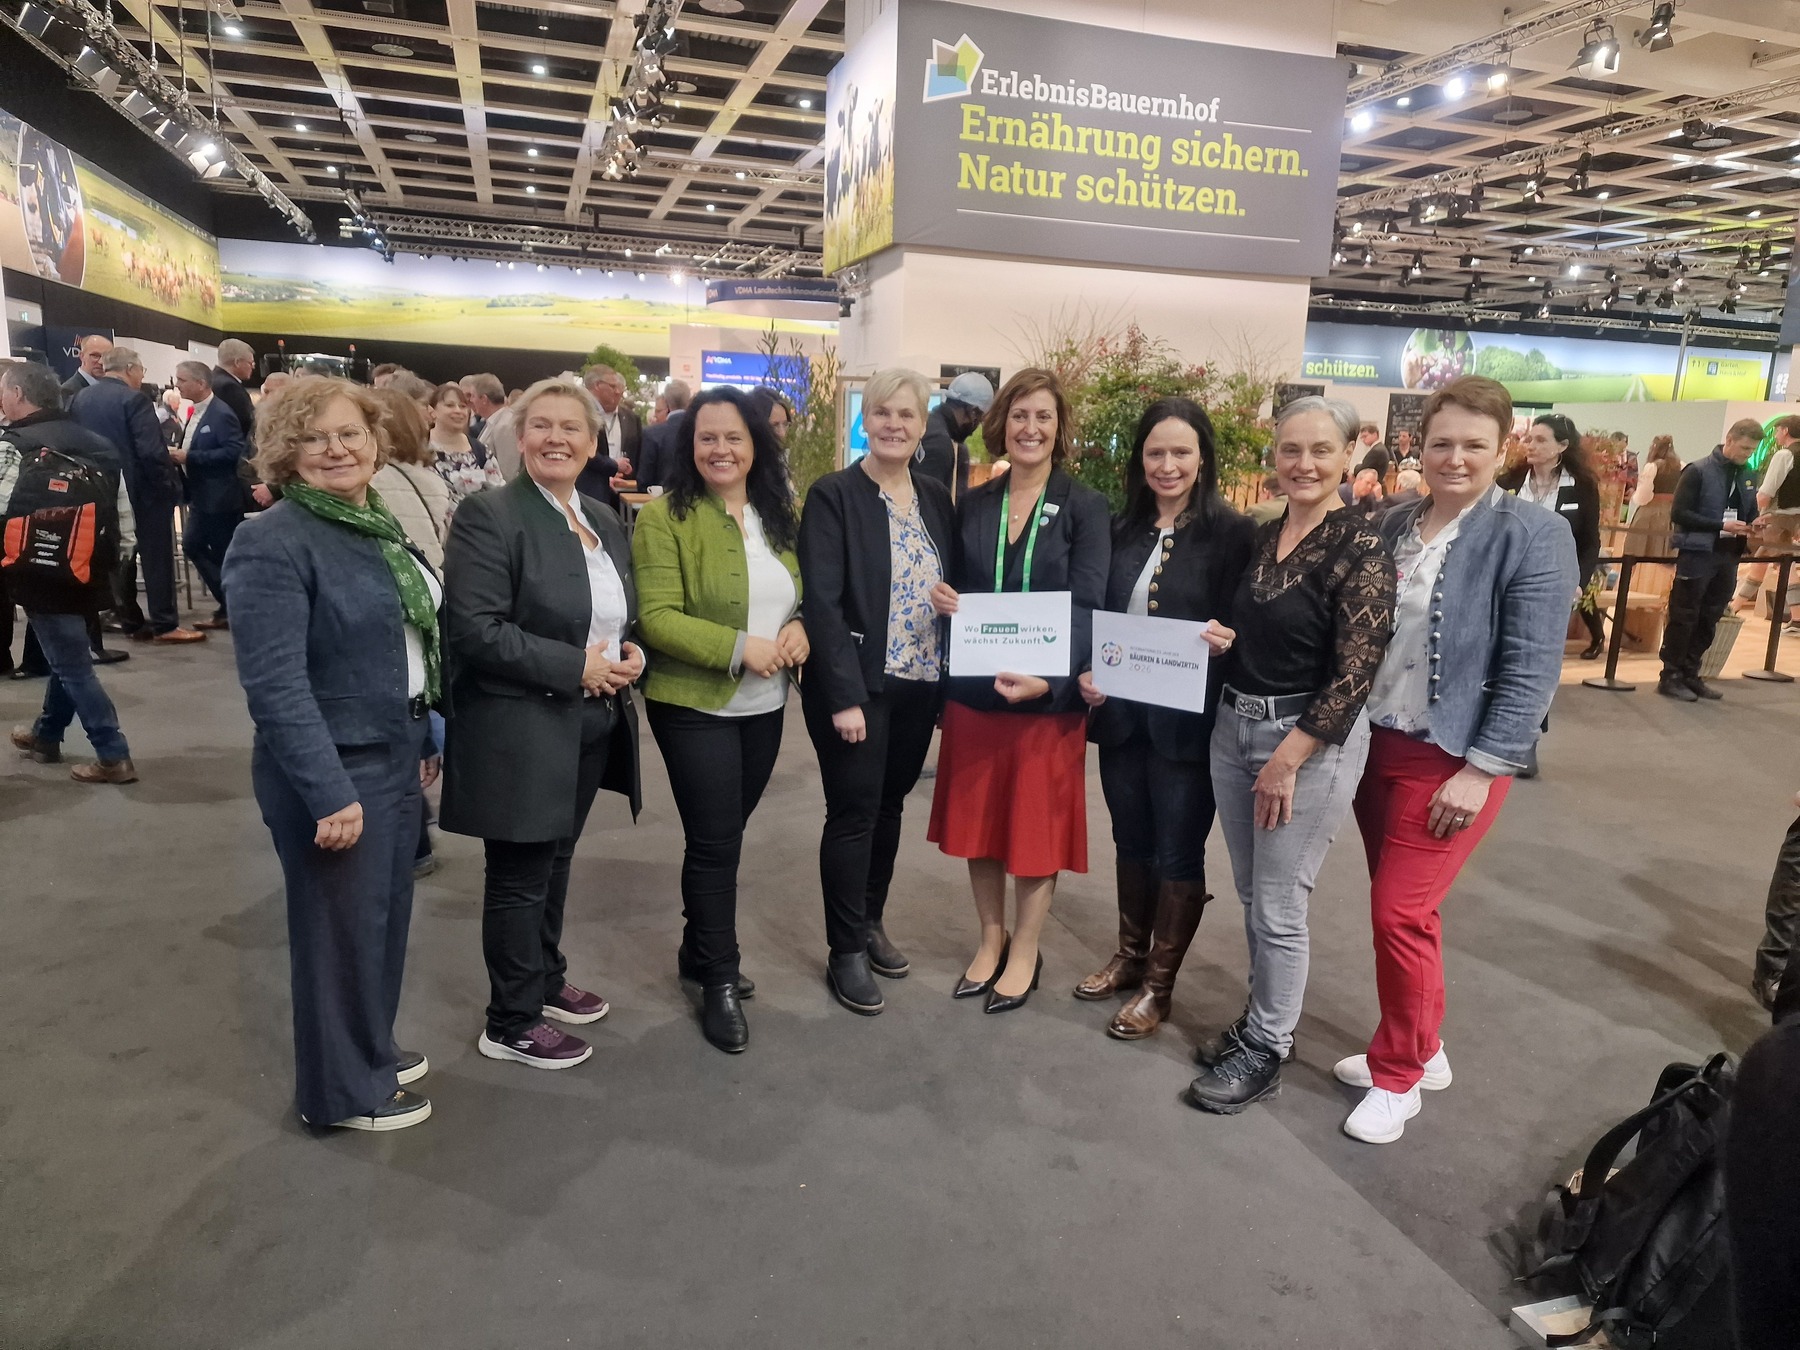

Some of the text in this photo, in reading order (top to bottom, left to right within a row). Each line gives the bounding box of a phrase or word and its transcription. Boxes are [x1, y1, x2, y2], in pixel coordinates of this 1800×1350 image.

[981, 68, 1221, 123] ErlebnisBauernhof
[959, 102, 1309, 177] Ernährung sichern.
[957, 152, 1246, 216] Natur schützen.
[1306, 358, 1379, 379] schützen.
[964, 624, 1057, 633] Wo Frauen wirken,
[963, 636, 998, 645] wächst
[1129, 652, 1154, 663] BÄUERIN
[1161, 658, 1199, 670] LANDWIRTIN
